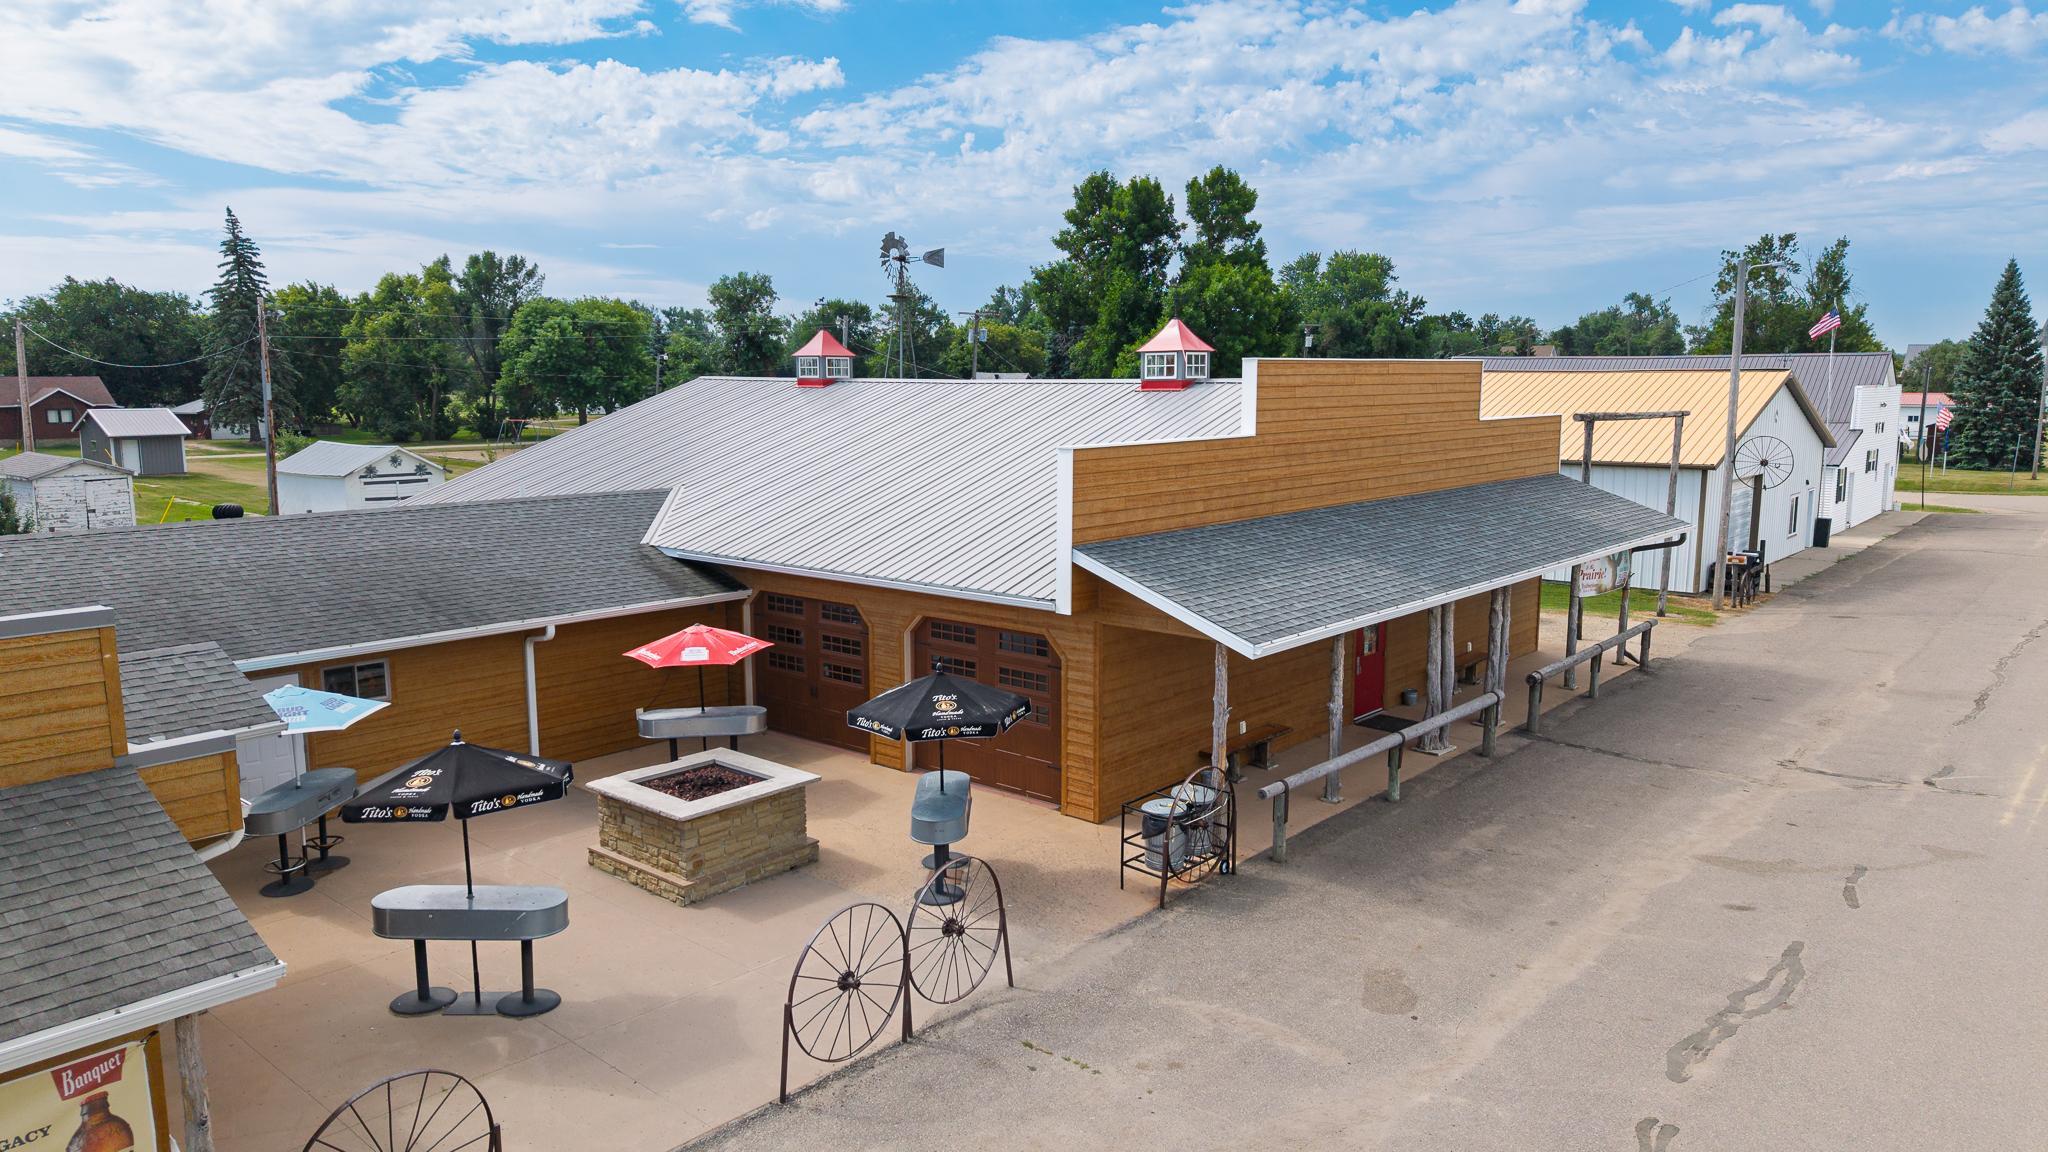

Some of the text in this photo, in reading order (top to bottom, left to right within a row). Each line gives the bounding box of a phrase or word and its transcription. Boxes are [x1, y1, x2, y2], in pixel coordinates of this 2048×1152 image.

[932, 693, 958, 702] Tito's
[922, 728, 947, 738] Tito's
[361, 806, 393, 819] Tito's
[471, 798, 501, 814] Tito's
[61, 1053, 122, 1097] Banquet
